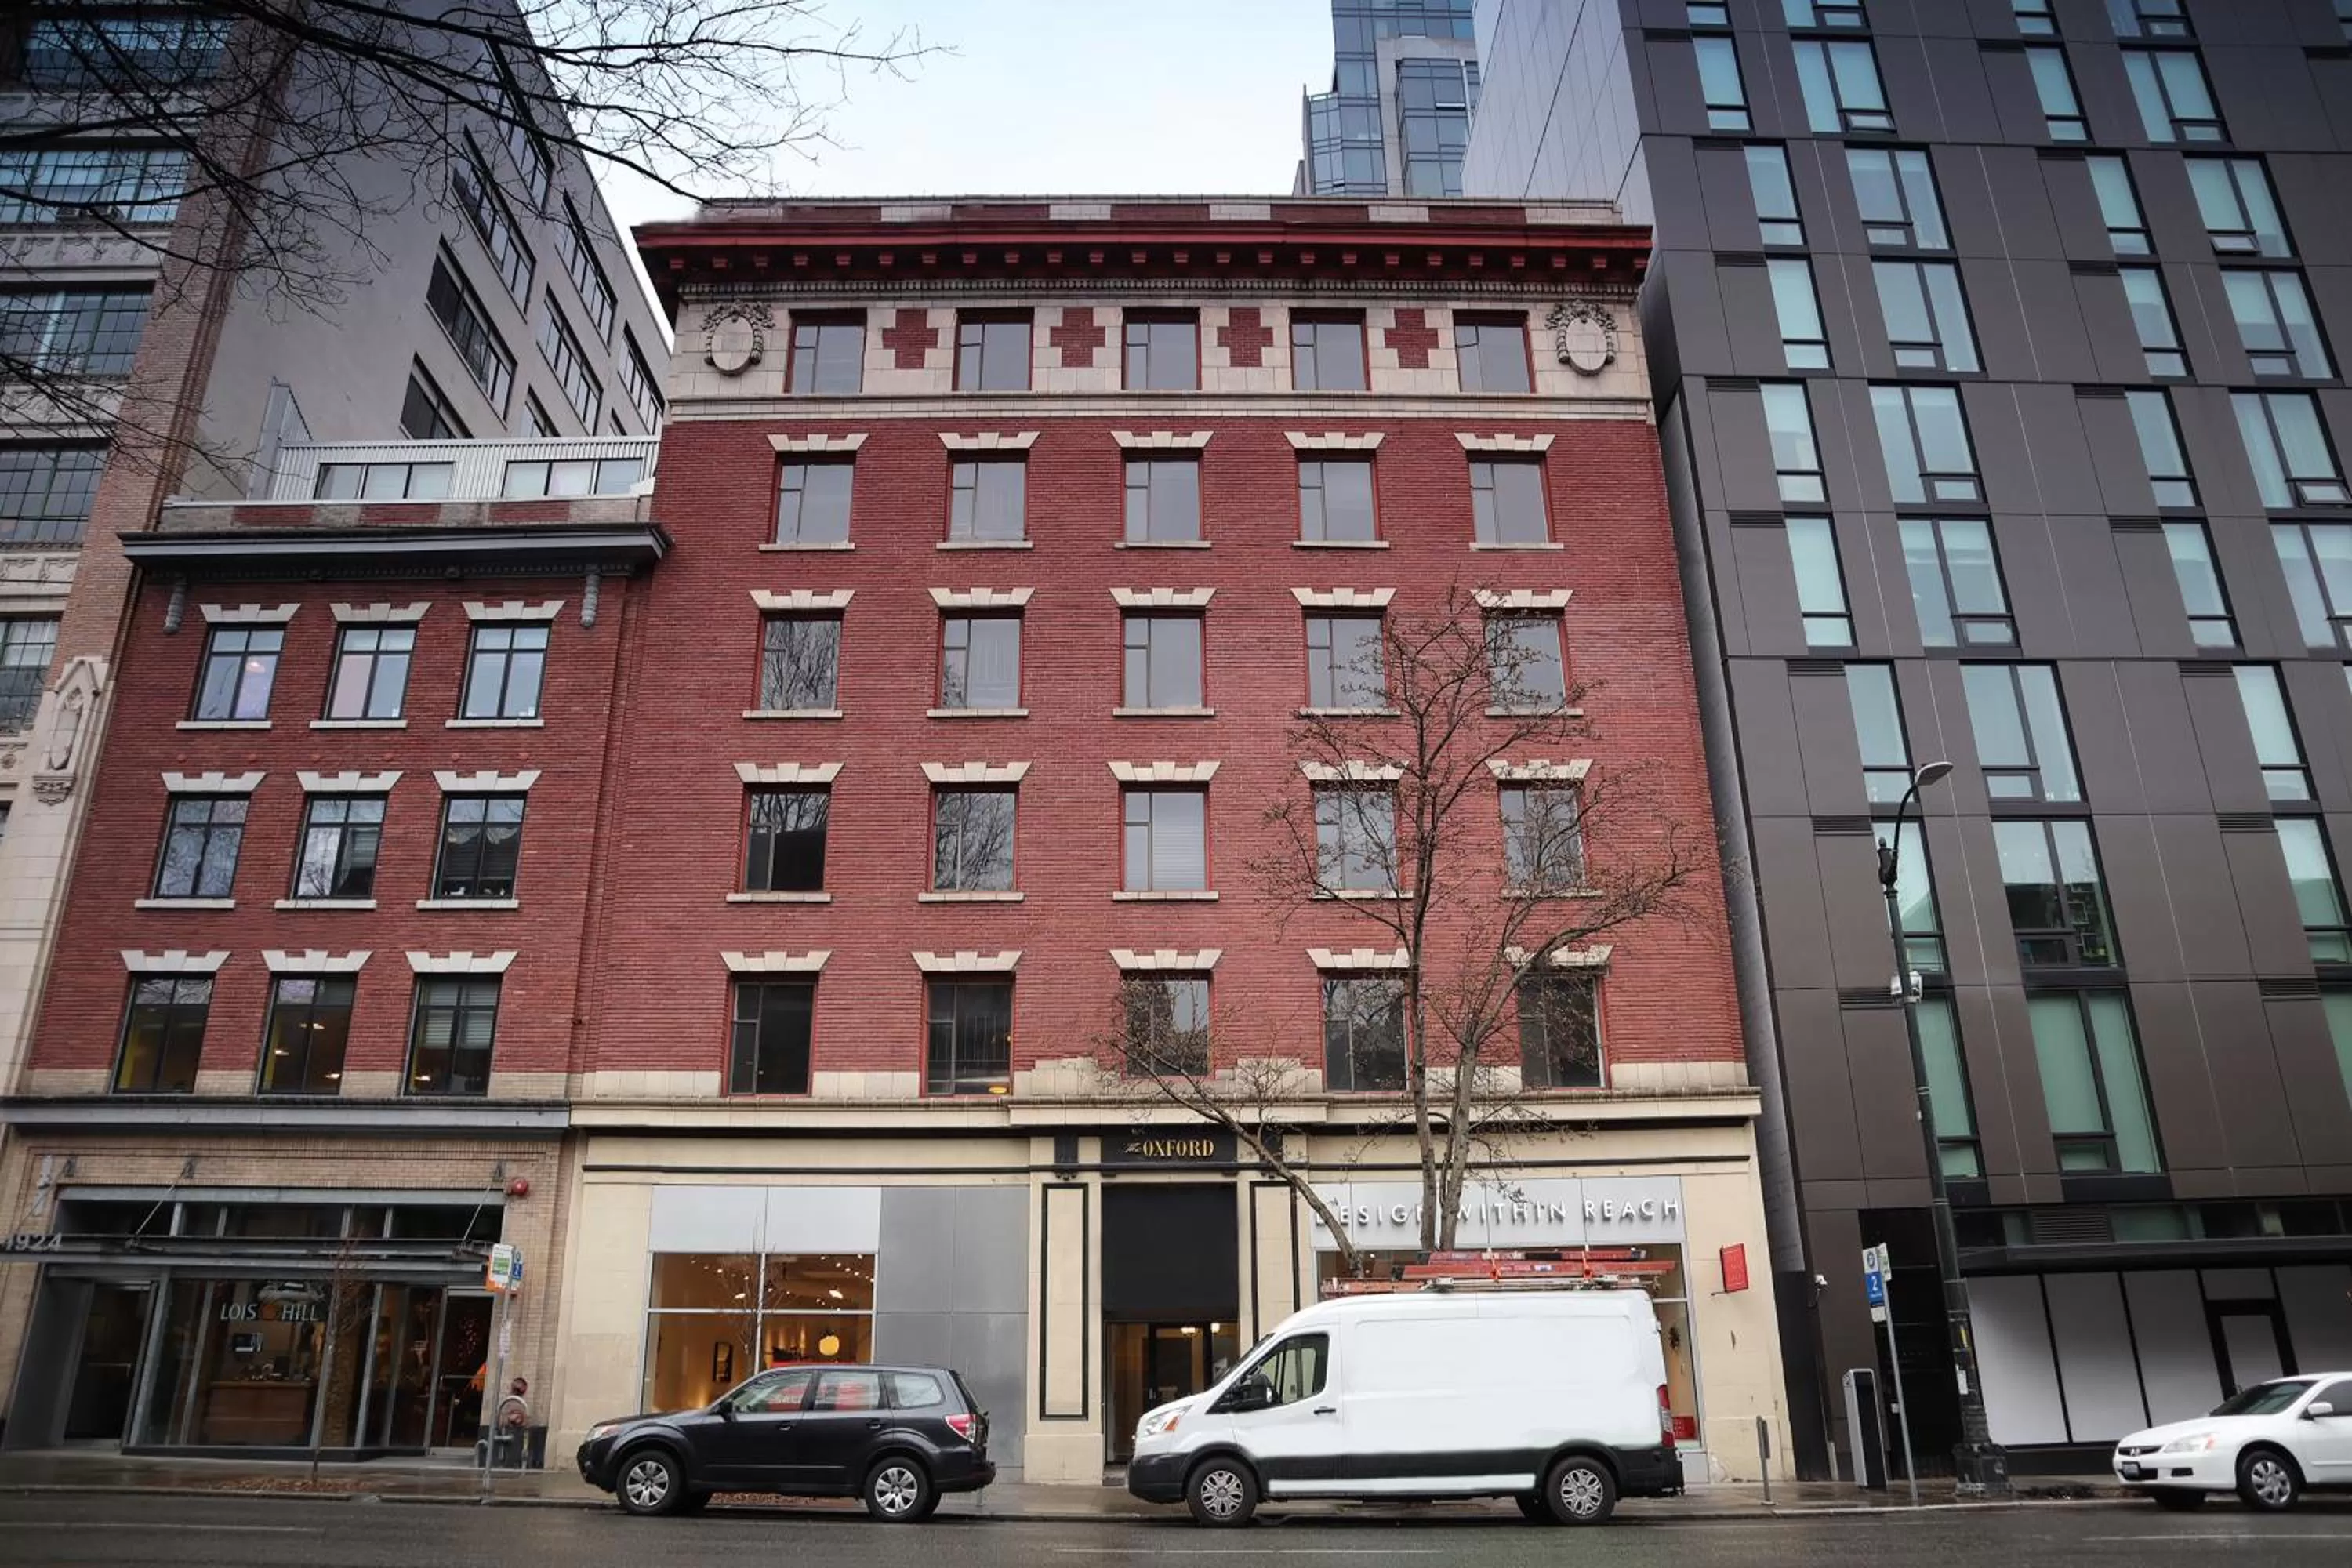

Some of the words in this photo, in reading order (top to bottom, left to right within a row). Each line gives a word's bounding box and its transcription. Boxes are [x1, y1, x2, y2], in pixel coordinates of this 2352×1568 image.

[1142, 1139, 1214, 1156] OXFORD
[1584, 1198, 1679, 1218] REACH
[5, 1232, 63, 1252] 1924
[220, 1303, 259, 1322] LOIS
[281, 1303, 319, 1322] HILL
